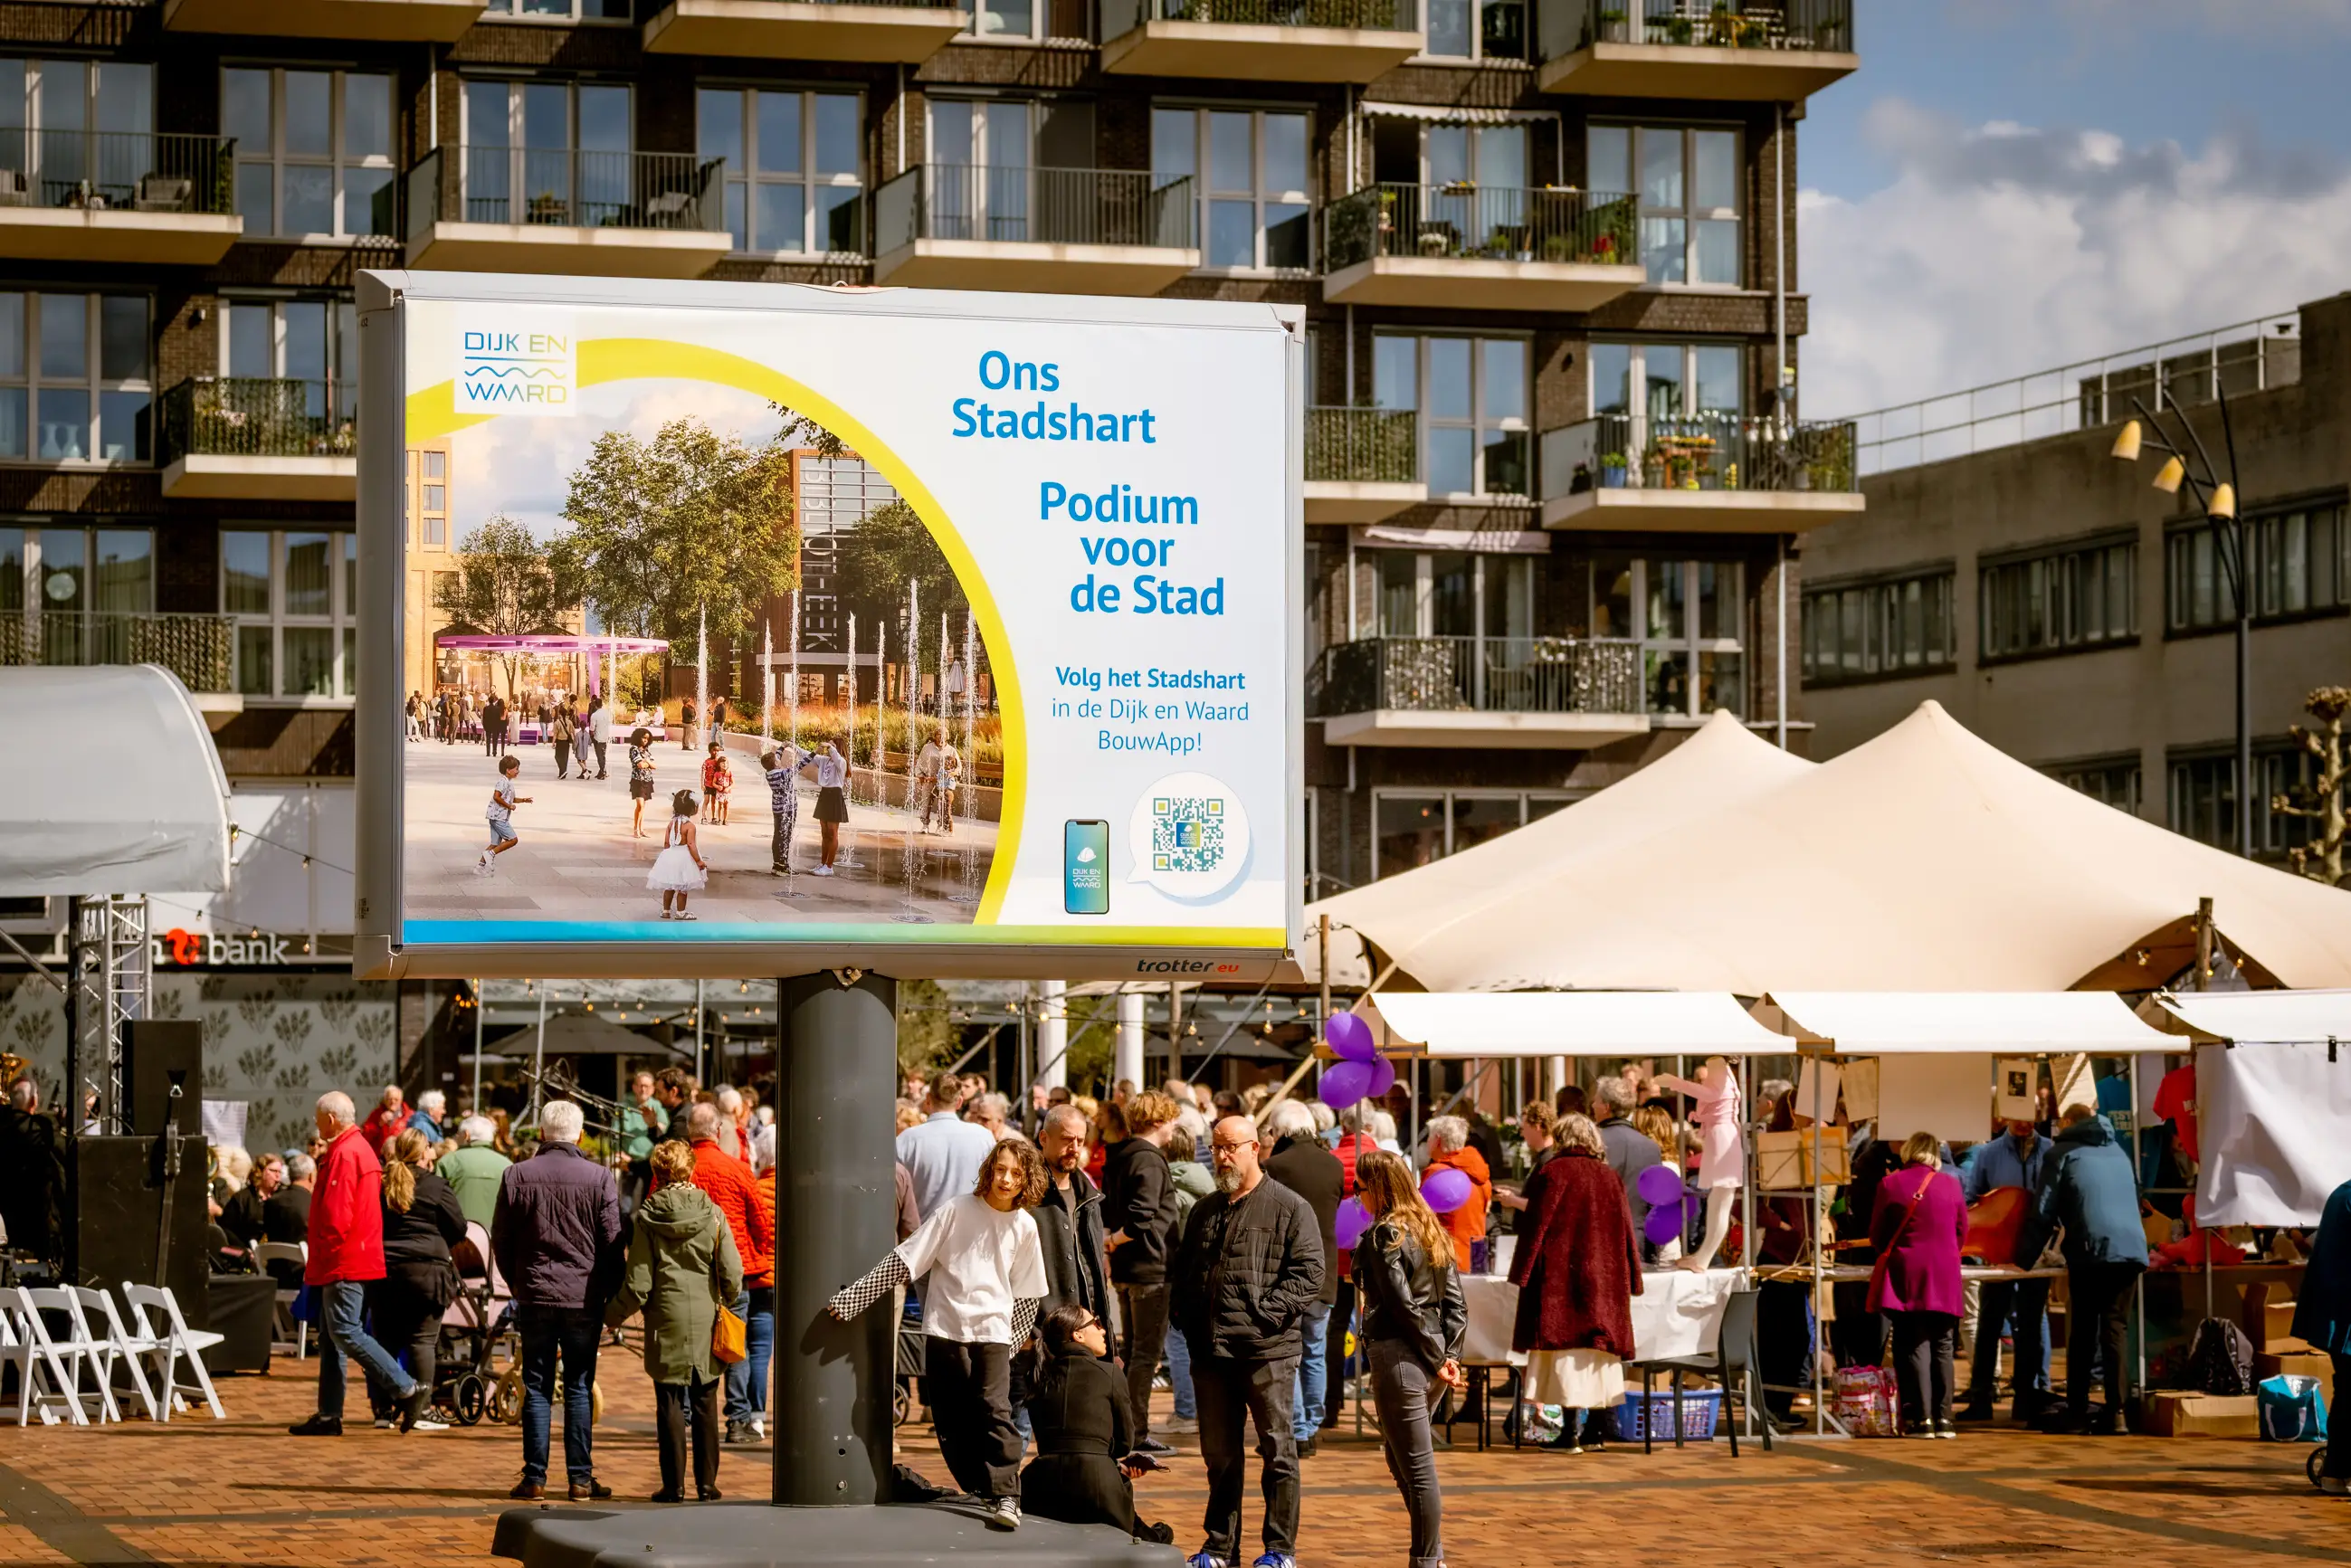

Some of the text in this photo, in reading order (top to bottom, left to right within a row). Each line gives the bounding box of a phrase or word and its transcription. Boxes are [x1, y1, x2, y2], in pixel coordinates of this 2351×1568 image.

[464, 331, 567, 354] DIJK EN
[978, 349, 1060, 392] Ons
[464, 382, 567, 404] WAARD
[952, 397, 1156, 444] Stadshart
[1040, 481, 1198, 525] Podium
[1080, 537, 1176, 567] voor
[1071, 574, 1224, 616] de Stad
[1055, 666, 1246, 692] Volg het Stadshart
[1052, 698, 1250, 724] in de Dijk en Waard
[1098, 730, 1202, 756] BouwApp!
[1090, 868, 1101, 876] EN
[207, 933, 289, 965] bank
